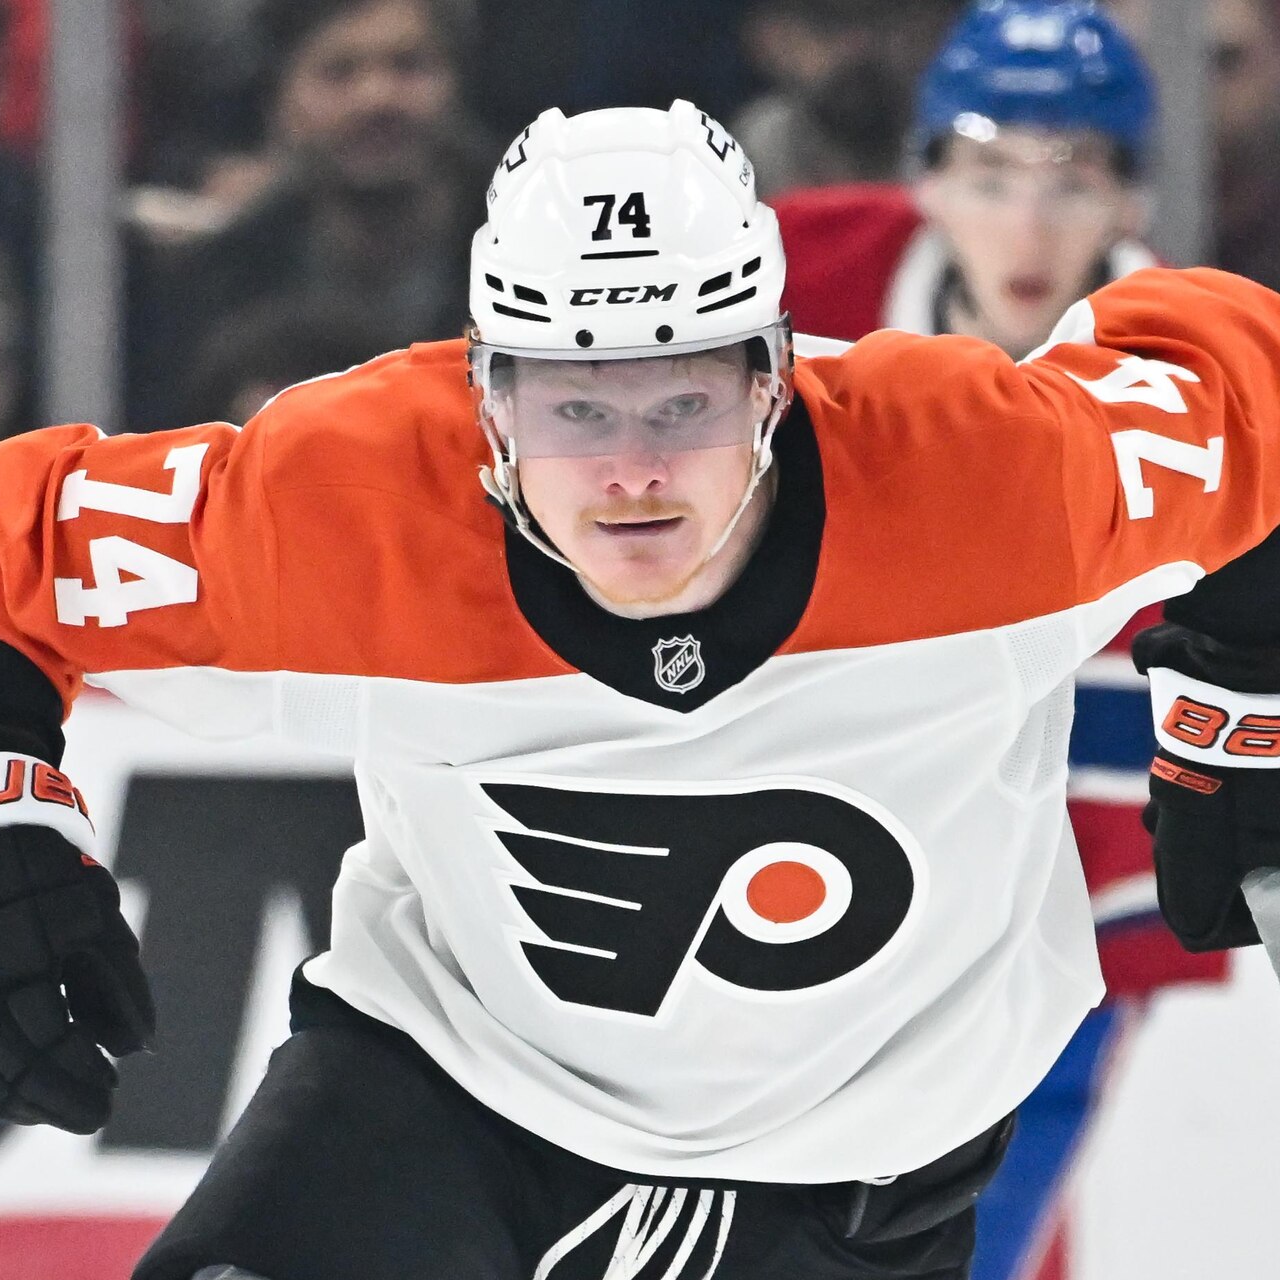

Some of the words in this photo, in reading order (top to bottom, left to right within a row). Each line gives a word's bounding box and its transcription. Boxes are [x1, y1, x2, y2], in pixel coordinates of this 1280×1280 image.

[582, 191, 652, 242] 74
[569, 282, 679, 307] CCM
[1064, 355, 1225, 520] 74
[54, 442, 210, 628] 74
[666, 649, 693, 682] NHL
